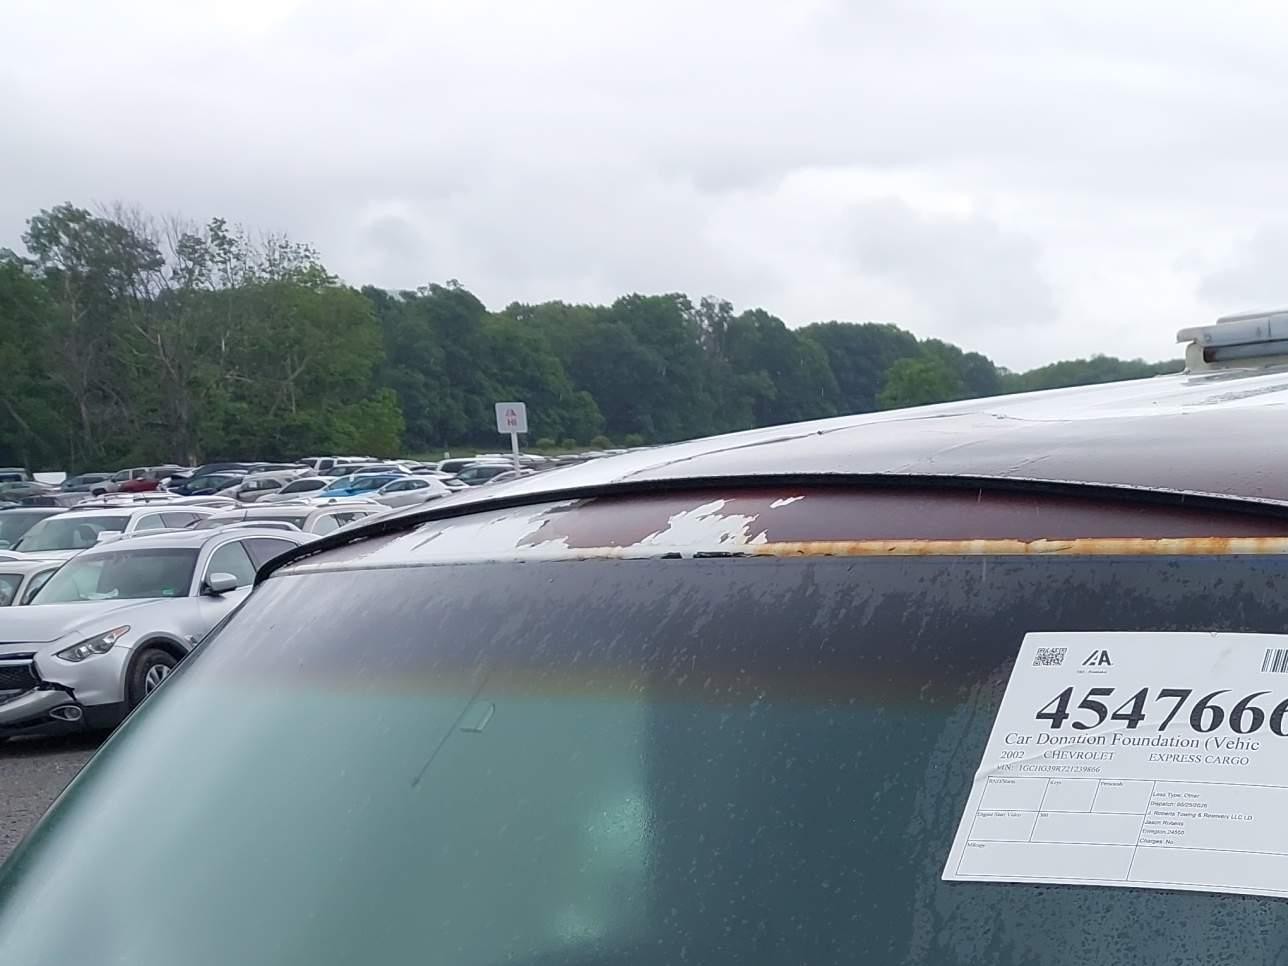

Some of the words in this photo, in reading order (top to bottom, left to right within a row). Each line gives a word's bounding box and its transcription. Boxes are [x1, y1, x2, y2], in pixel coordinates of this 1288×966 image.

[1004, 732, 1032, 745] Car
[1036, 732, 1106, 746] Donation
[1111, 732, 1200, 749] Foundation
[1204, 736, 1260, 752] (Vehic
[999, 750, 1025, 760] 2002
[1043, 749, 1115, 761] CHEVROLET
[1148, 753, 1202, 763] EXPRESS
[1204, 754, 1250, 766] CARGO
